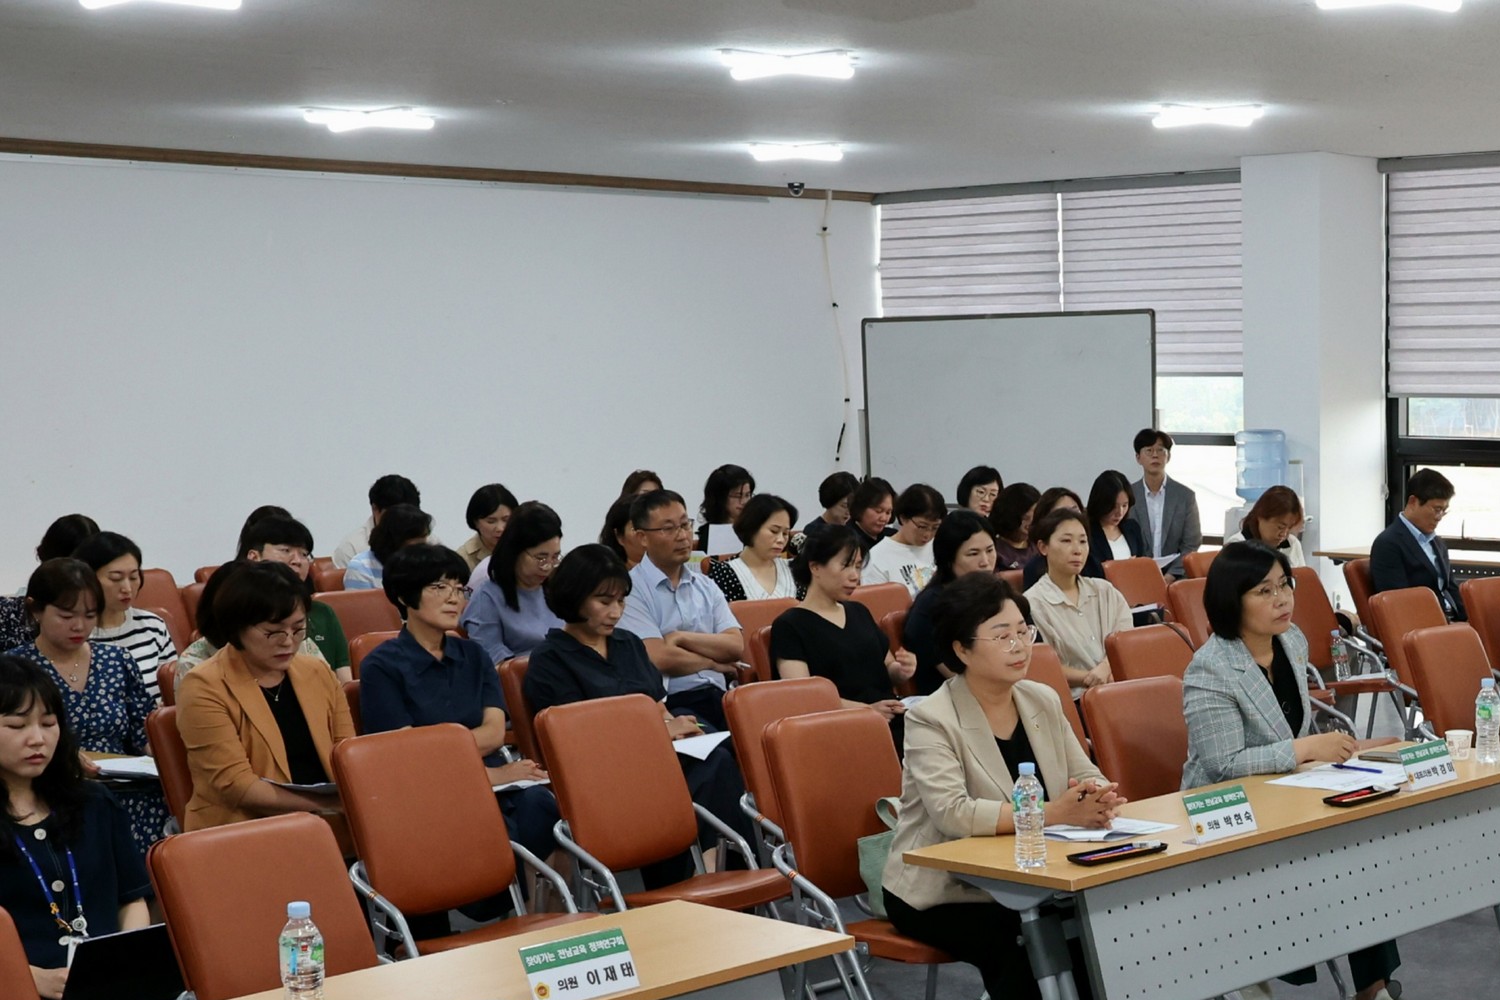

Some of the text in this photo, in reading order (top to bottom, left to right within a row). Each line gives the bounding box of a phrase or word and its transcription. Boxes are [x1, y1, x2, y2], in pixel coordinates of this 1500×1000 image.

[1207, 819, 1221, 831] 의원
[525, 952, 556, 967] 찾아가는
[557, 944, 588, 960] 전남교육
[557, 976, 579, 991] 의원
